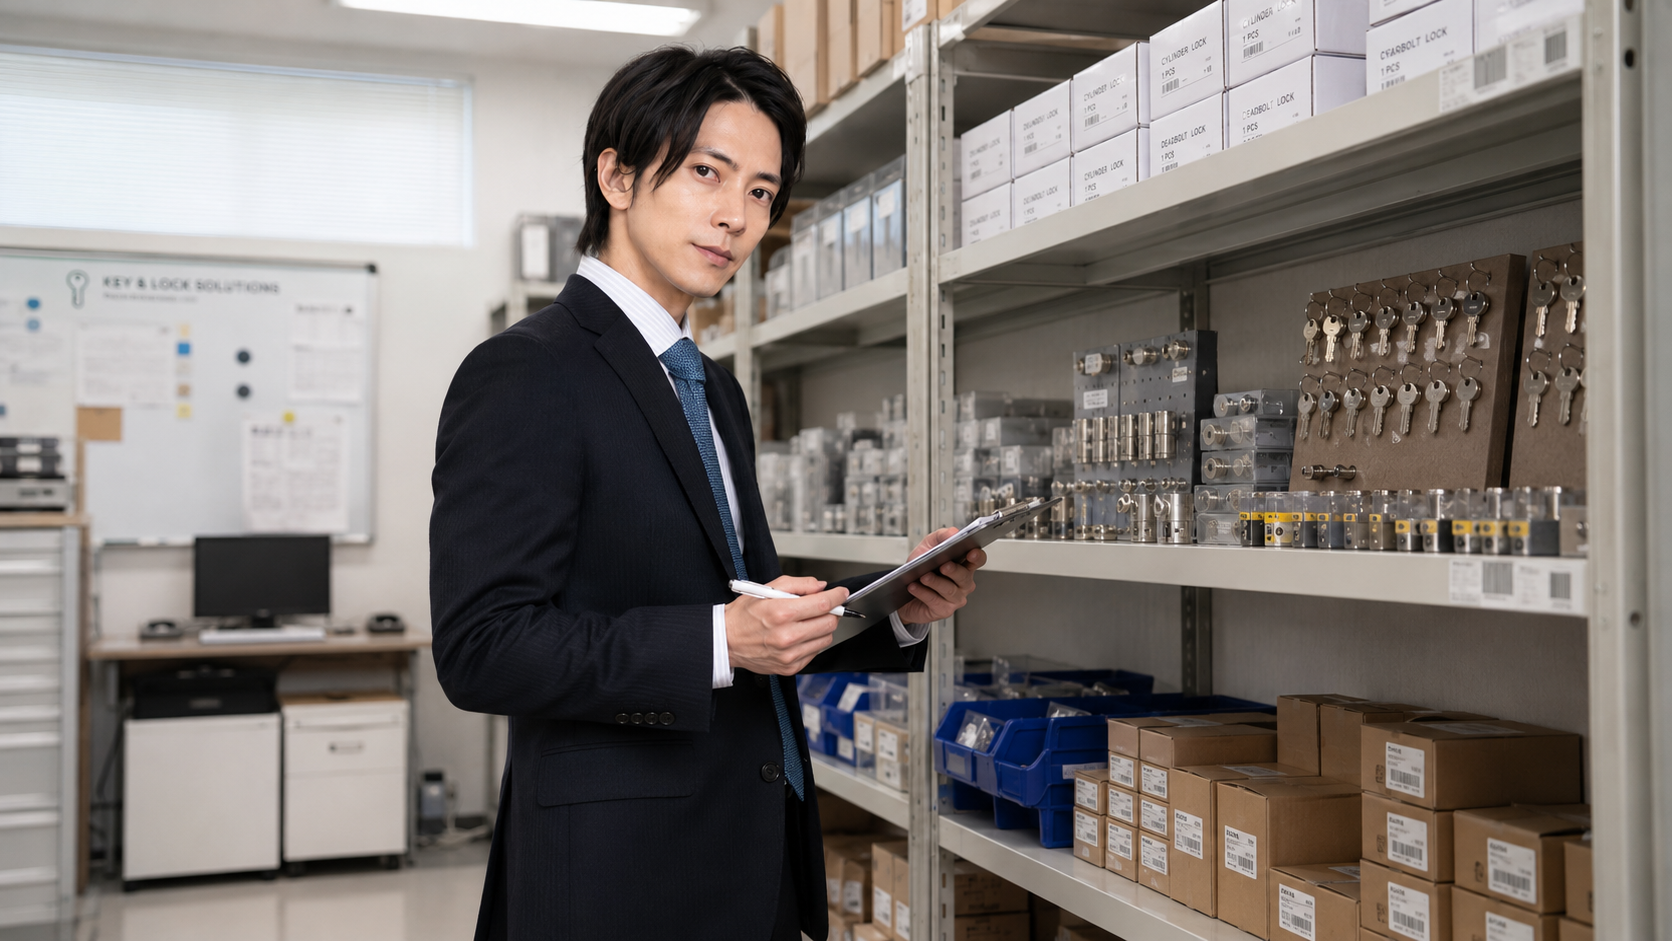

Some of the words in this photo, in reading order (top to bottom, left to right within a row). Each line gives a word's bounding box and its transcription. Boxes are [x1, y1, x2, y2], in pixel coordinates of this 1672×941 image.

[1247, 29, 1259, 40] PCS
[1425, 26, 1447, 43] LOCK
[1161, 46, 1189, 66] CYLINDER
[1191, 36, 1207, 51] LOCK
[1165, 66, 1176, 77] PCS
[1386, 61, 1400, 74] PCS
[1110, 75, 1126, 90] LOC
[1277, 92, 1295, 107] LOCK
[1191, 124, 1206, 138] LOCK
[1247, 121, 1259, 133] PCS
[1164, 150, 1175, 160] PCS
[1110, 159, 1124, 171] LOCK
[102, 275, 132, 290] KEY
[137, 275, 148, 290] &
[150, 276, 192, 292] LOCK
[196, 277, 281, 296] SOLUTIONS
